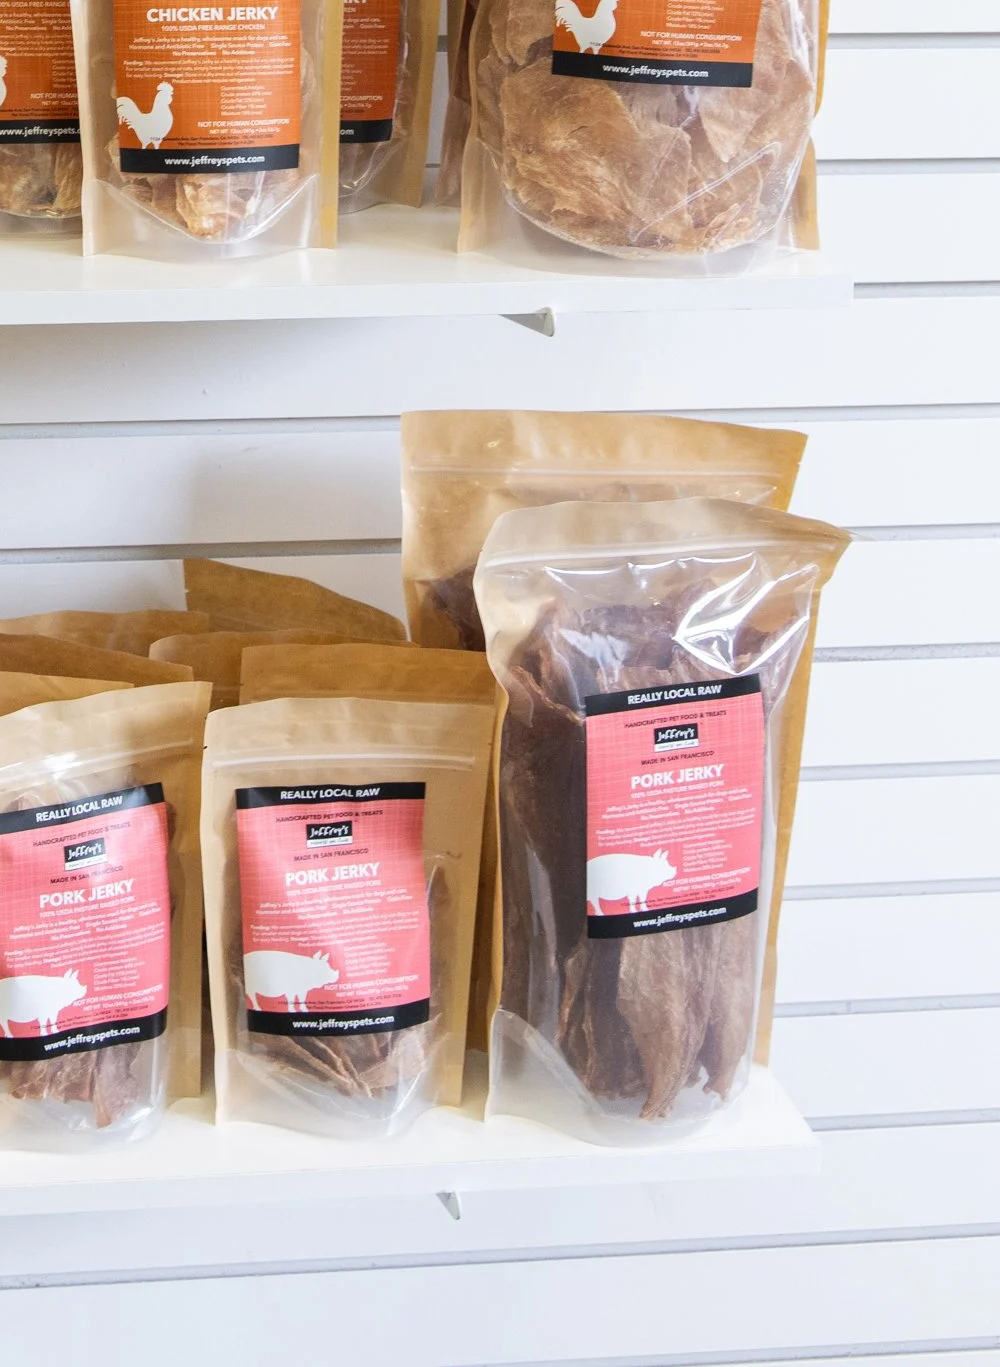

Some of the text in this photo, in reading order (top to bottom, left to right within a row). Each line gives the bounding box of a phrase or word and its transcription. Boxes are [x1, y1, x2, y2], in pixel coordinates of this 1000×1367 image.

[147, 7, 278, 23] CHICKEN JERKY
[603, 64, 708, 78] www.jeffreyspets.com
[165, 155, 265, 167] www.jeffreyspets.com
[628, 685, 722, 705] REALLY LOCAL RAW
[657, 728, 694, 742] Jeffrey's
[631, 764, 724, 789] PORK JERKY
[280, 788, 380, 799] REALLY LOCAL RAW
[36, 795, 123, 822] REALLY LOCAL RAW
[310, 825, 348, 838] Jeffrey's
[68, 843, 102, 860] Jeffrey's
[286, 863, 380, 887] PORK JERKY
[39, 879, 134, 908] PORK JERKY
[634, 907, 727, 928] www.jeffreyspets.com
[293, 1016, 394, 1030] www.jeffreyspets.com
[43, 1025, 140, 1051] www.jeffreyspets.com
